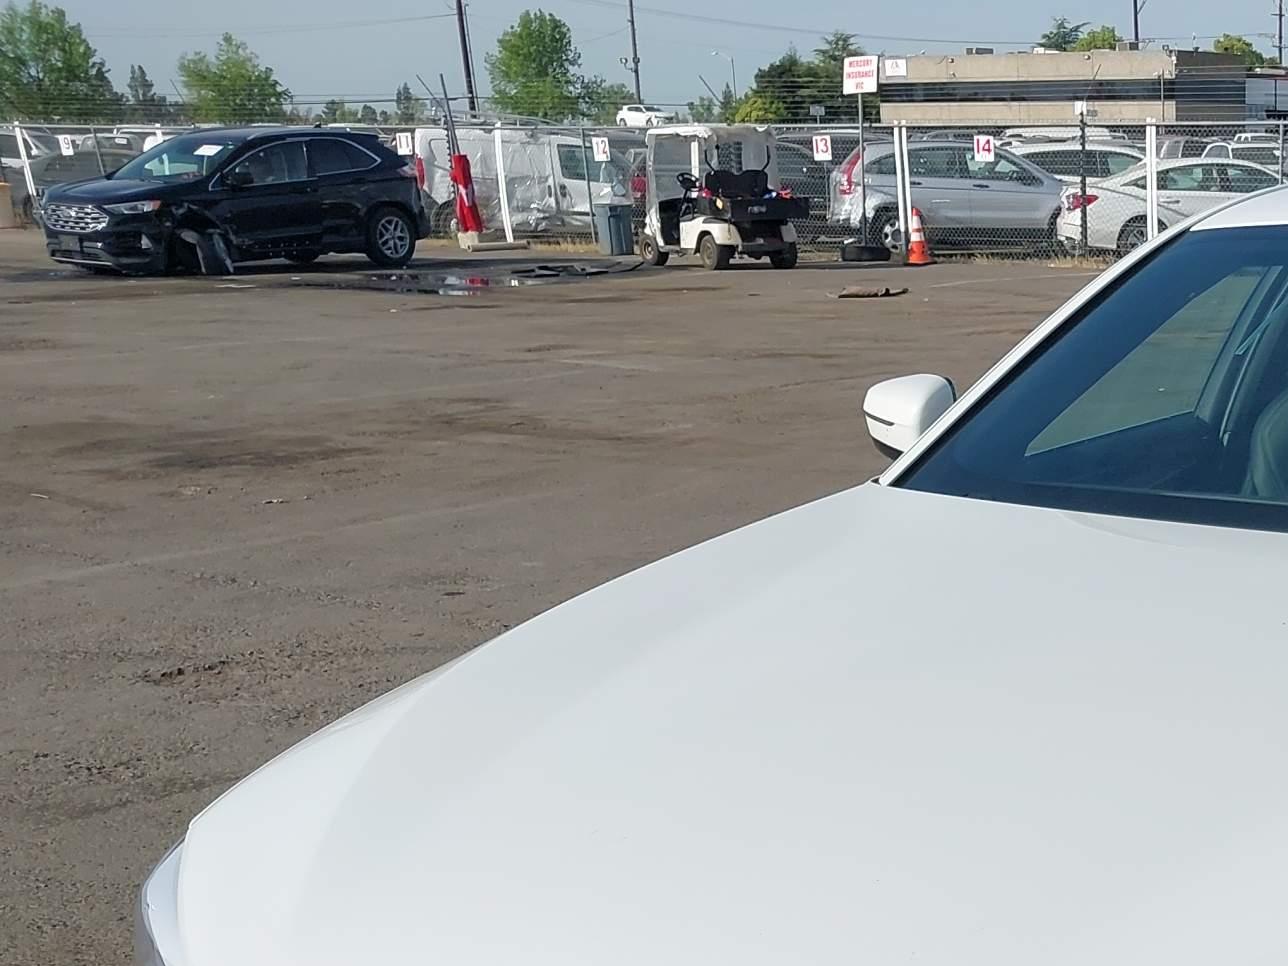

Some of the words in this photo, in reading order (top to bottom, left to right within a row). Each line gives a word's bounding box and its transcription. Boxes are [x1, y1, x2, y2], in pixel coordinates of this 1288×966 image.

[846, 70, 874, 79] INSURANCE
[64, 136, 70, 150] 9
[595, 140, 607, 154] 12
[815, 138, 829, 153] 13
[976, 138, 992, 154] 14
